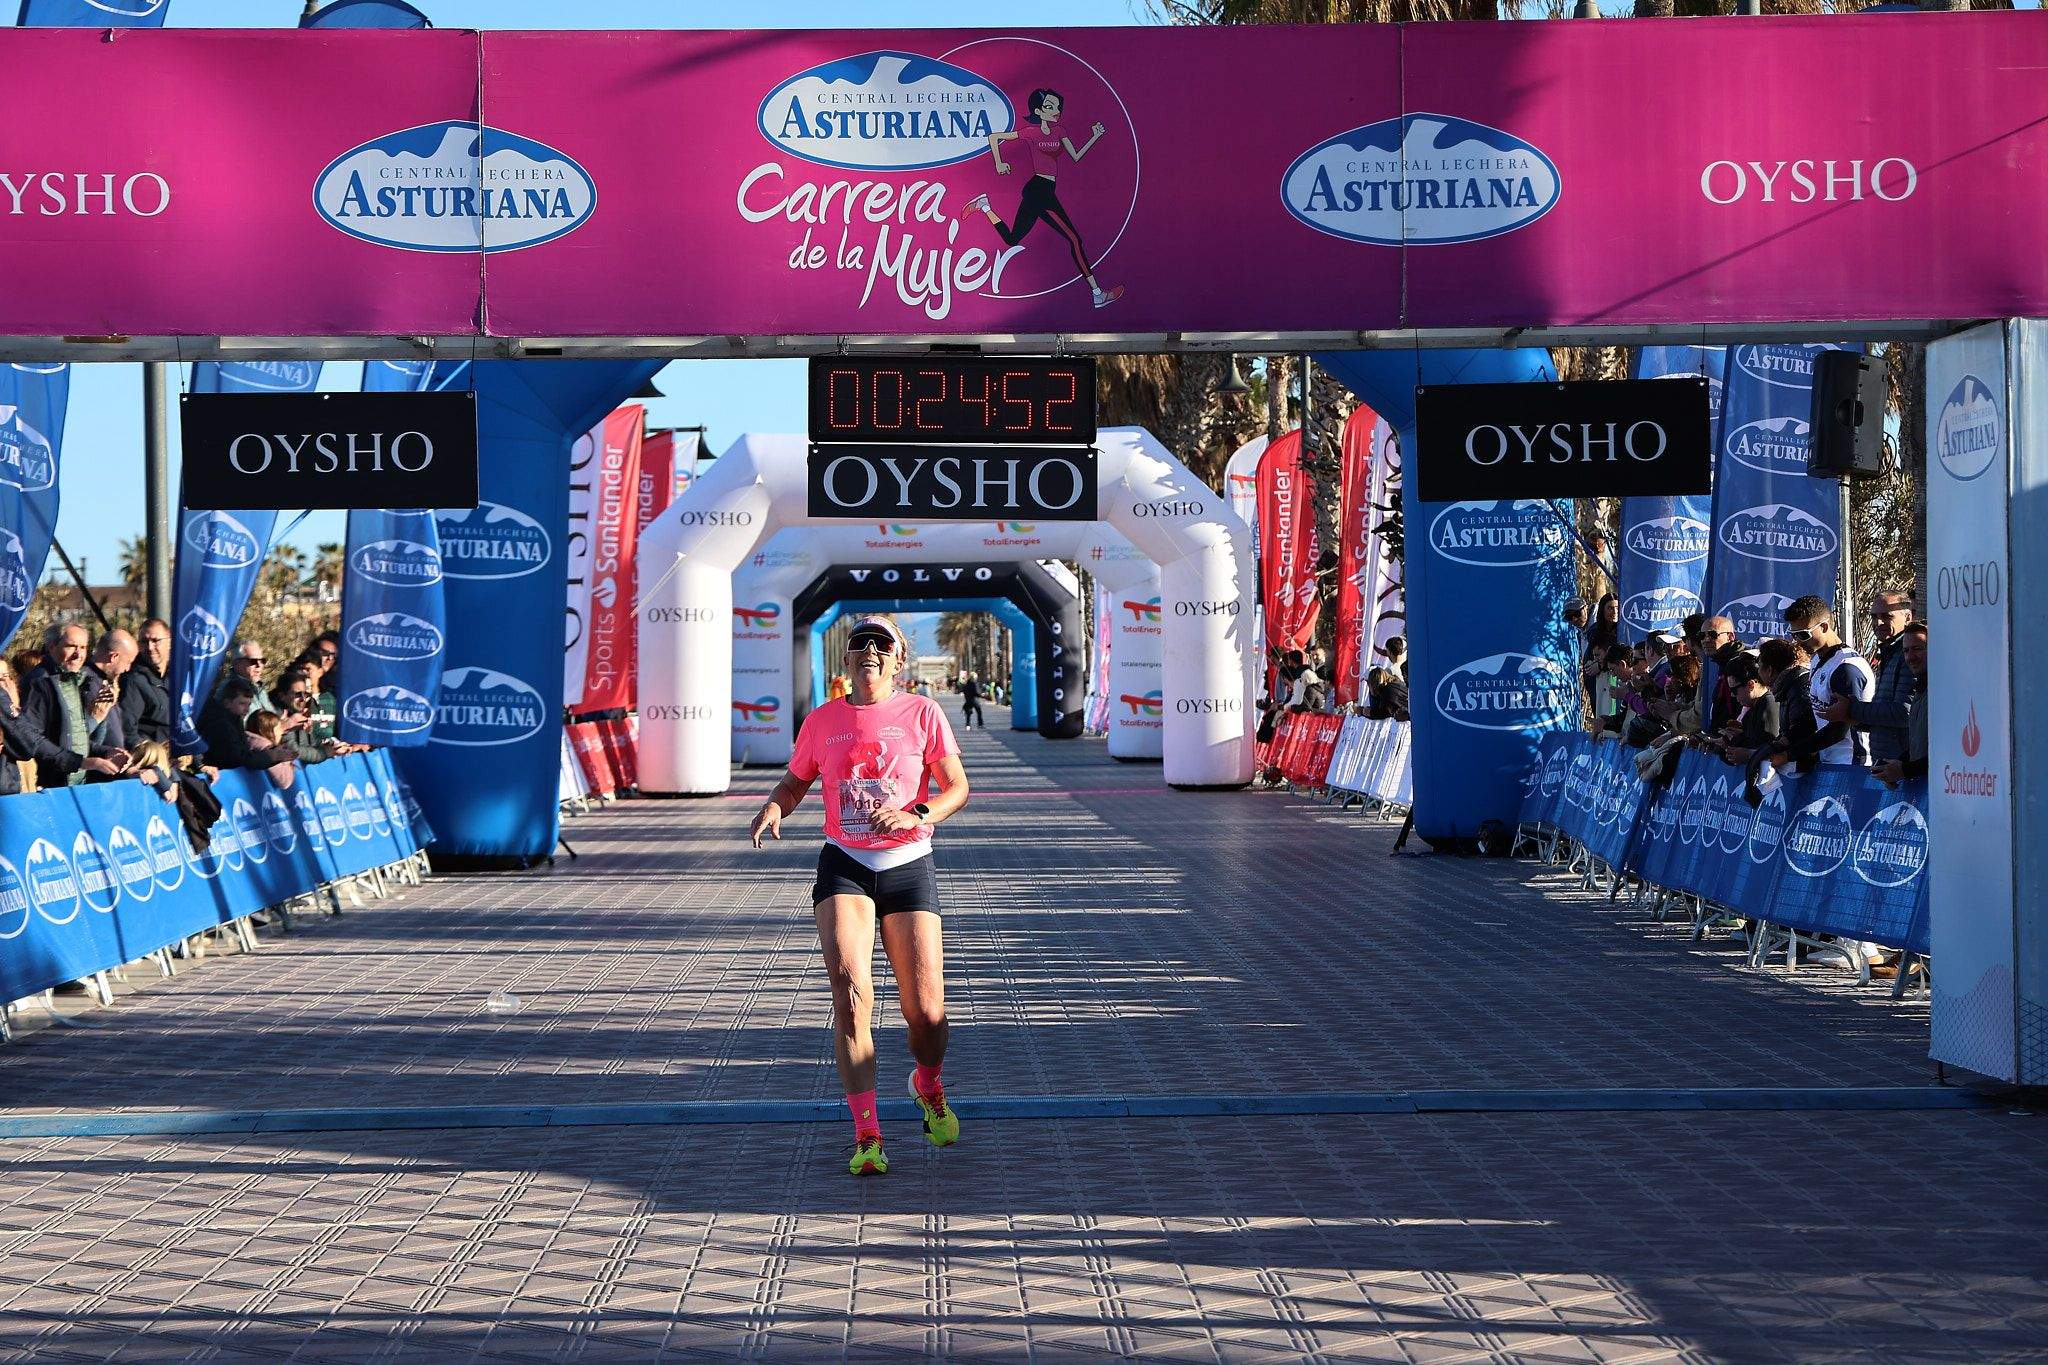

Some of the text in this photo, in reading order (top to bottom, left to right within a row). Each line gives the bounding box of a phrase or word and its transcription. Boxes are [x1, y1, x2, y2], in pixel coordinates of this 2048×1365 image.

[817, 92, 987, 104] CENTRAL LECHERA
[778, 94, 993, 140] ASTURIANA
[379, 167, 565, 180] CENTRAL LECHERA
[1346, 158, 1530, 173] CENTRAL LECHERA
[336, 169, 575, 218] ASTURIANA
[736, 162, 946, 225] Carrera
[1303, 164, 1540, 212] ASTURIANA
[1701, 158, 1918, 204] OYSHO
[788, 218, 1025, 320] de la Mujer
[1745, 345, 1814, 375] ASTURI
[830, 371, 1075, 429] 00:24:52
[1465, 421, 1668, 466] OYSHO
[1735, 433, 1812, 463] ASTURIA
[1942, 420, 1997, 457] ASTURIANA
[229, 431, 434, 474] OYSHO
[823, 455, 1084, 511] OYSHO
[681, 511, 752, 526] OYSHO
[1133, 502, 1203, 518] OYSHO
[1274, 468, 1294, 578] Santander
[1461, 516, 1513, 525] CENTRAL
[982, 536, 1041, 546] TotalEnergies
[1632, 530, 1710, 551] ASTURIANA
[1727, 521, 1827, 551] ASTURIANA
[1746, 521, 1824, 535] CENTRAL LECHERA
[358, 552, 440, 577] ASTURIANA
[588, 444, 624, 691] Sports Santander
[849, 567, 993, 582] VOLVO
[1937, 561, 2000, 610] OYSHO
[648, 607, 714, 622] OYSHO
[1174, 601, 1241, 616] OYSHO
[1627, 601, 1697, 622] ASTURIANA
[355, 626, 437, 651] ASTURIANA
[1052, 622, 1065, 723] VOLVO
[1466, 680, 1519, 688] CENTRAL
[647, 705, 712, 721] OYSHO
[1176, 699, 1242, 713] OYSHO
[826, 733, 854, 746] OYSHO
[1944, 764, 1997, 797] Santander
